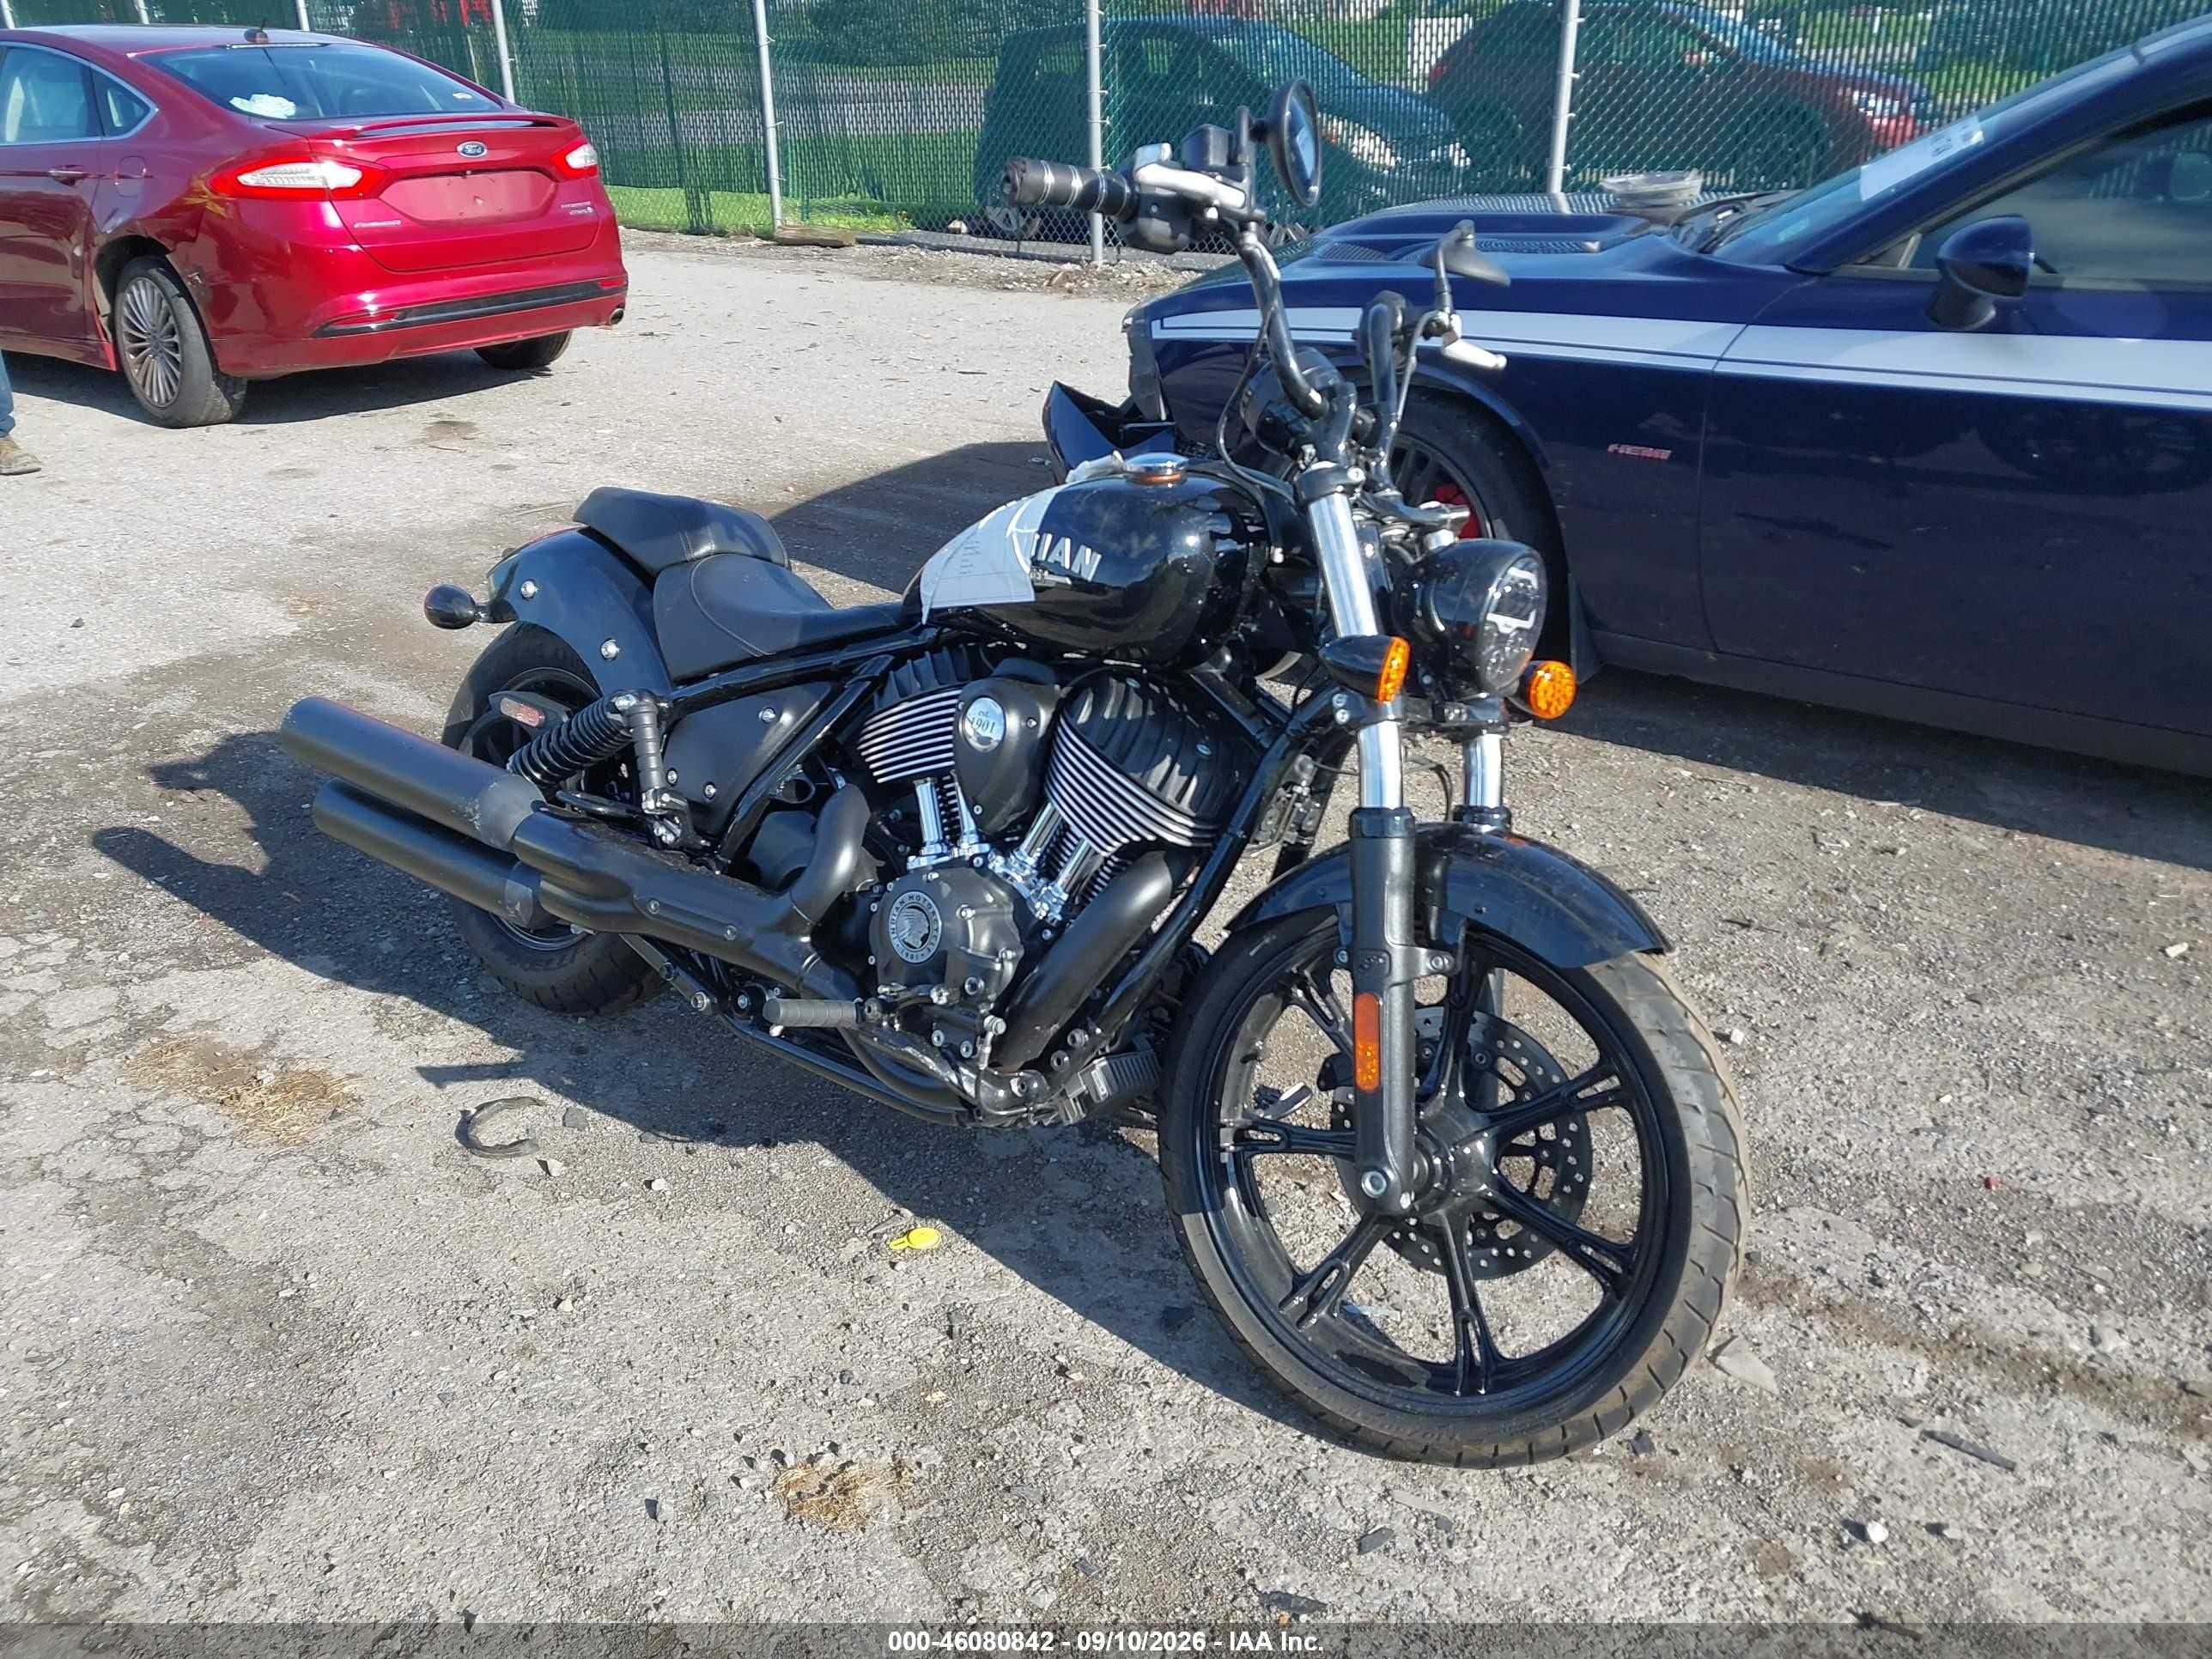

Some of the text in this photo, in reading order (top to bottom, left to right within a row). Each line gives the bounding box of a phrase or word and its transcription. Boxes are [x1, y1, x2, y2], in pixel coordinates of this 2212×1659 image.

[1030, 532, 1103, 583] IAN
[970, 716, 996, 734] 1901
[890, 894, 940, 953] INDIAN MOTORCYCLE
